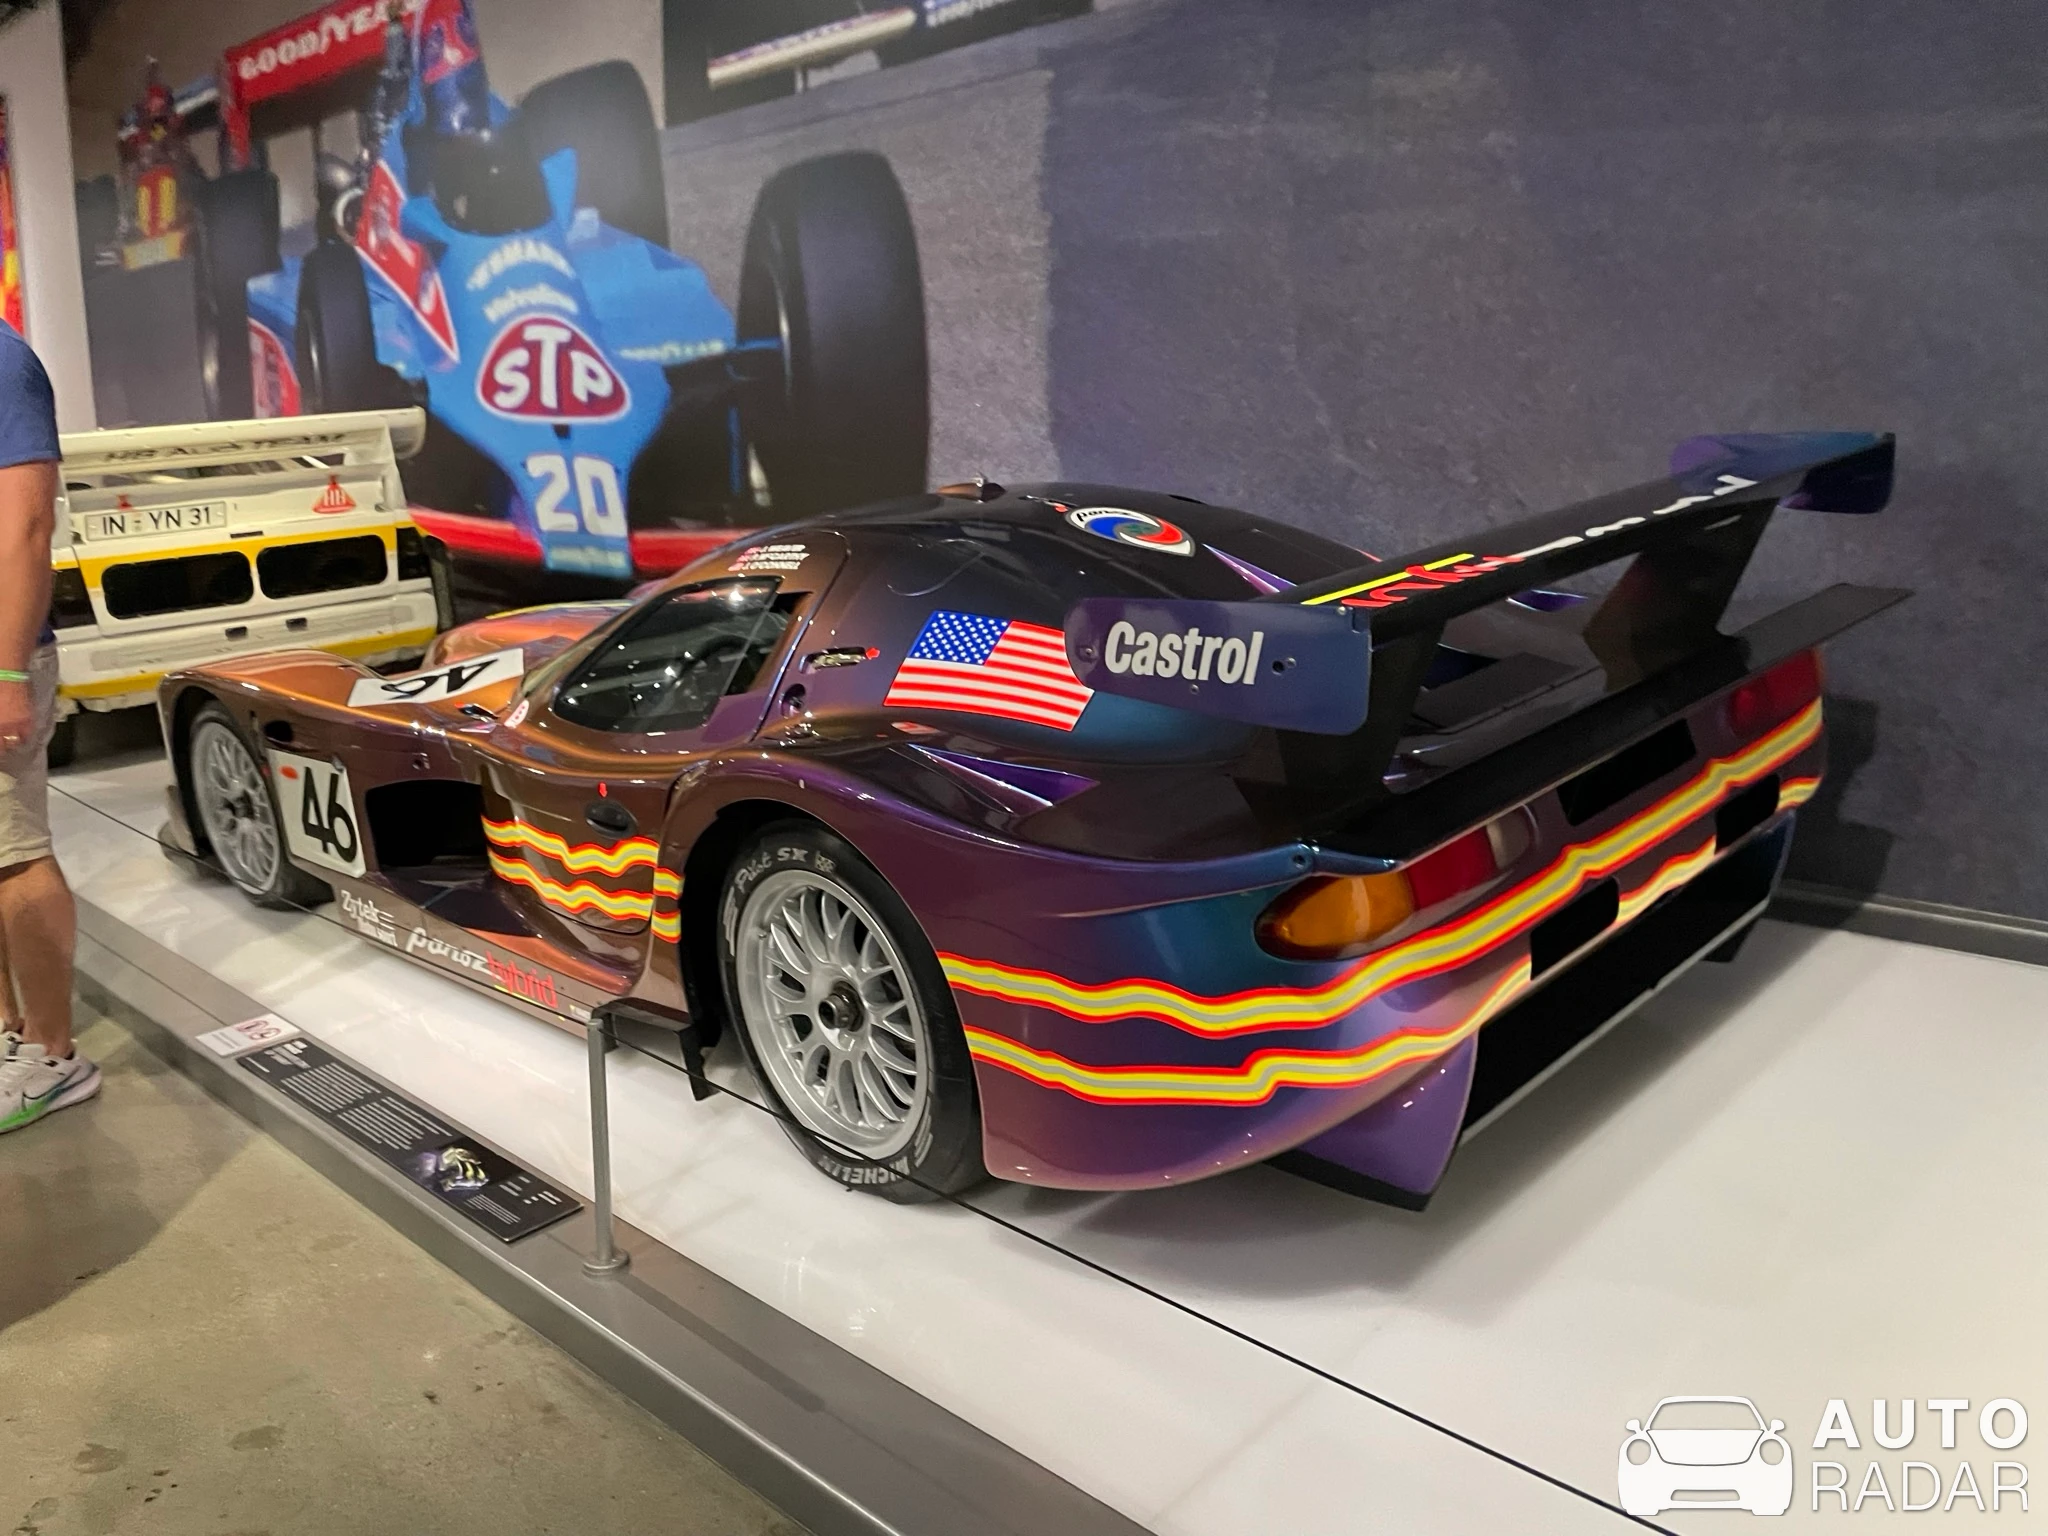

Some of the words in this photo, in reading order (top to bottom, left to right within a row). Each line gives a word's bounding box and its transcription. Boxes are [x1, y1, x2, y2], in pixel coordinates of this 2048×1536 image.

[493, 324, 614, 409] STP
[102, 514, 125, 535] IN
[148, 509, 181, 530] YN
[189, 506, 211, 526] 31
[526, 454, 628, 538] 20
[1105, 621, 1264, 685] Castrol
[302, 766, 357, 863] 46
[777, 847, 809, 862] SX
